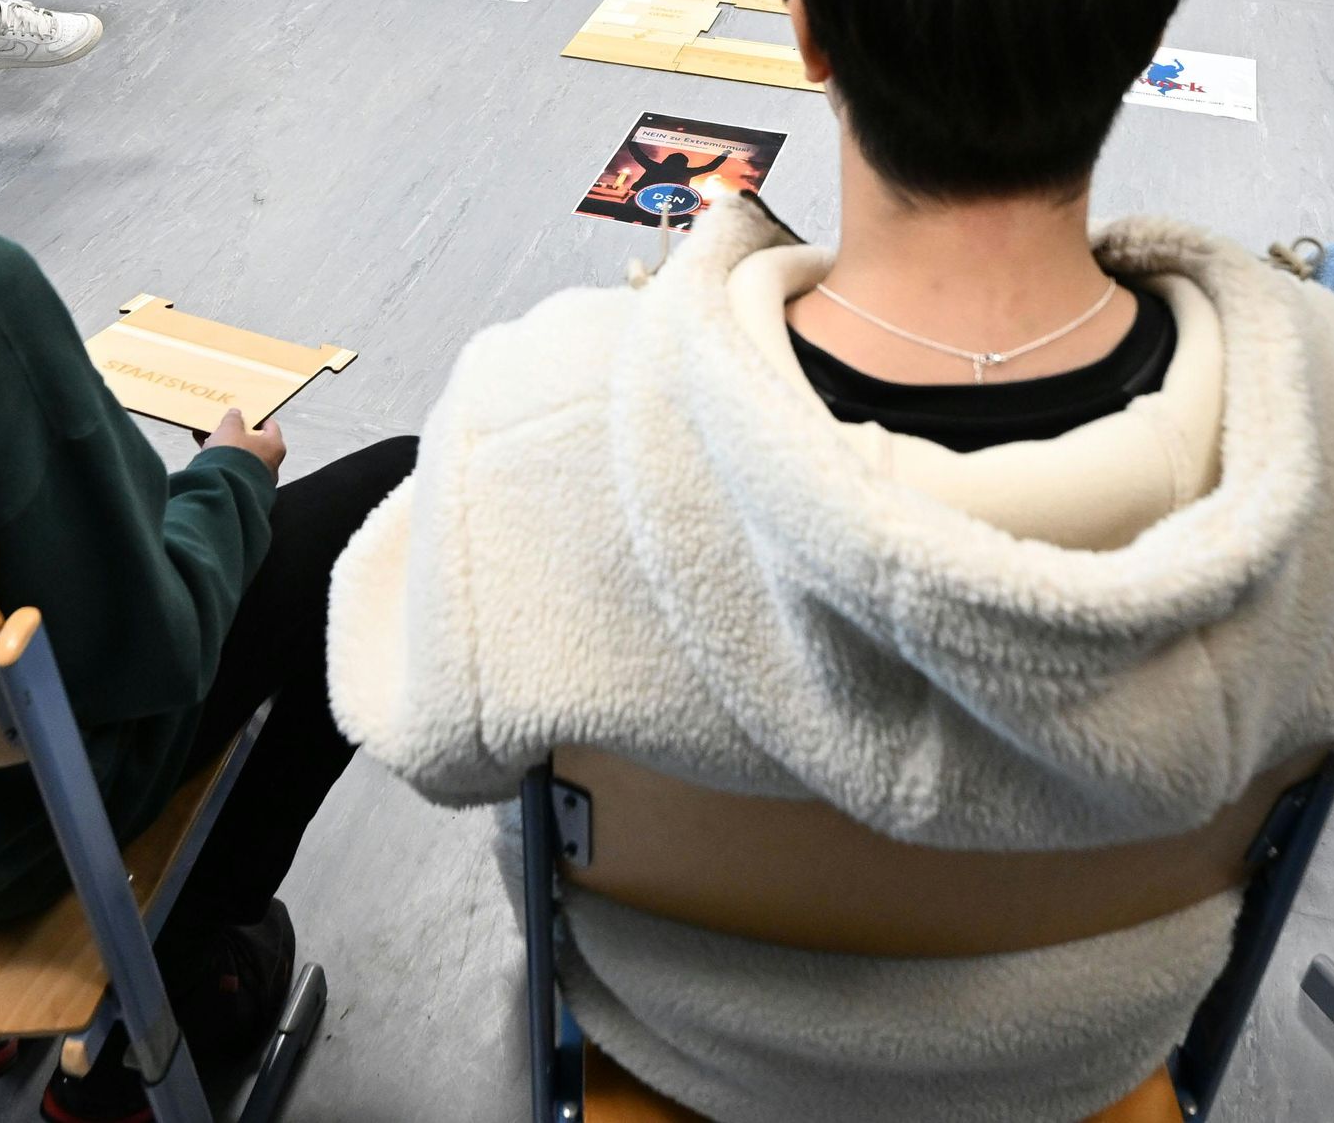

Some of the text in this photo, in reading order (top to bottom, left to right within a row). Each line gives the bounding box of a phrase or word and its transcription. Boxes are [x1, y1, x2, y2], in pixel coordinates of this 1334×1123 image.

[642, 130, 668, 139] NEIN
[652, 192, 686, 204] DSN
[102, 359, 236, 405] STAATSVOLK
